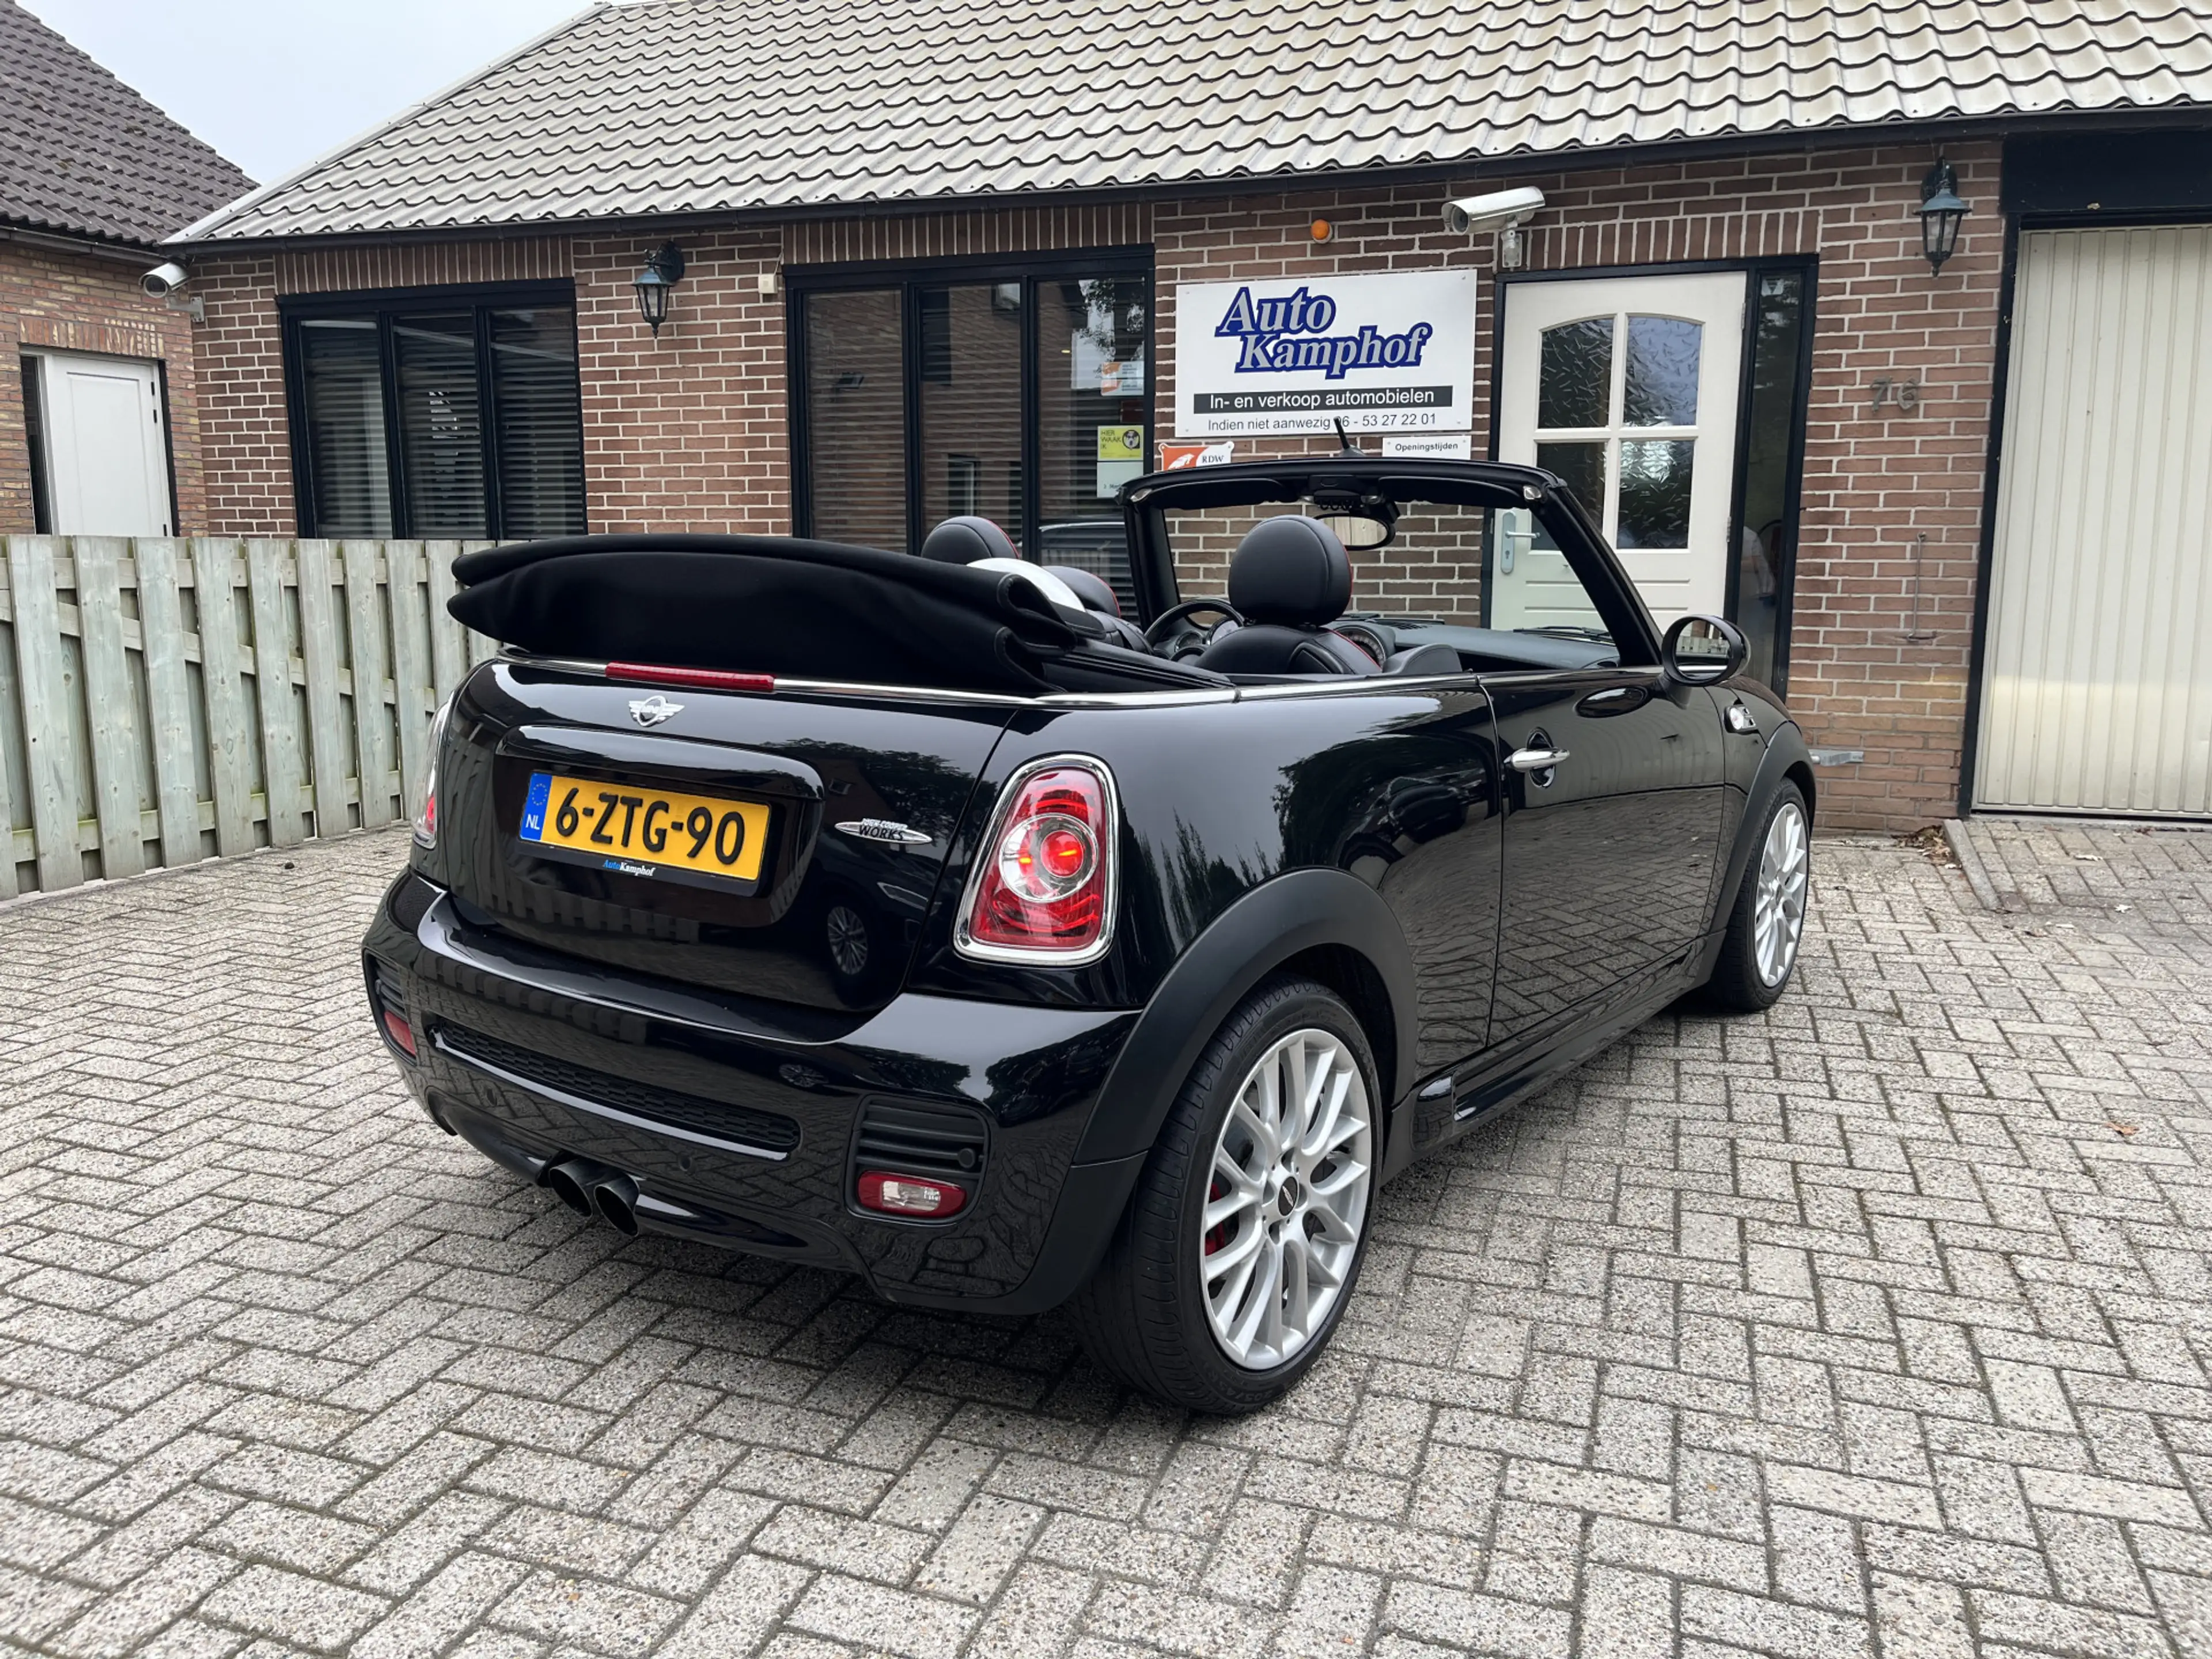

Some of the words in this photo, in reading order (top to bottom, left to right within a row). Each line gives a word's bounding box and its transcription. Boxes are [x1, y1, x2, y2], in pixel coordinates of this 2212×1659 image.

[1214, 286, 1336, 336] Auto
[1234, 322, 1433, 379] Kamphof
[1210, 394, 1230, 409] In-
[1234, 395, 1253, 408] en
[1258, 392, 1320, 410] verkoop
[1325, 388, 1434, 406] automobielen
[1870, 376, 1919, 411] 76
[1208, 419, 1244, 431] Indien
[1247, 418, 1270, 430] niet
[1272, 416, 1331, 430] aanwezig
[1362, 415, 1378, 426] 53
[1381, 414, 1397, 426] 27
[1401, 413, 1417, 425] 22
[1421, 412, 1436, 425] 01
[1395, 442, 1459, 452] Openingstijden
[1202, 454, 1225, 463] RDW
[525, 814, 540, 830] NL
[556, 787, 745, 865] 6-ZTG-90
[858, 825, 904, 840] WORKS
